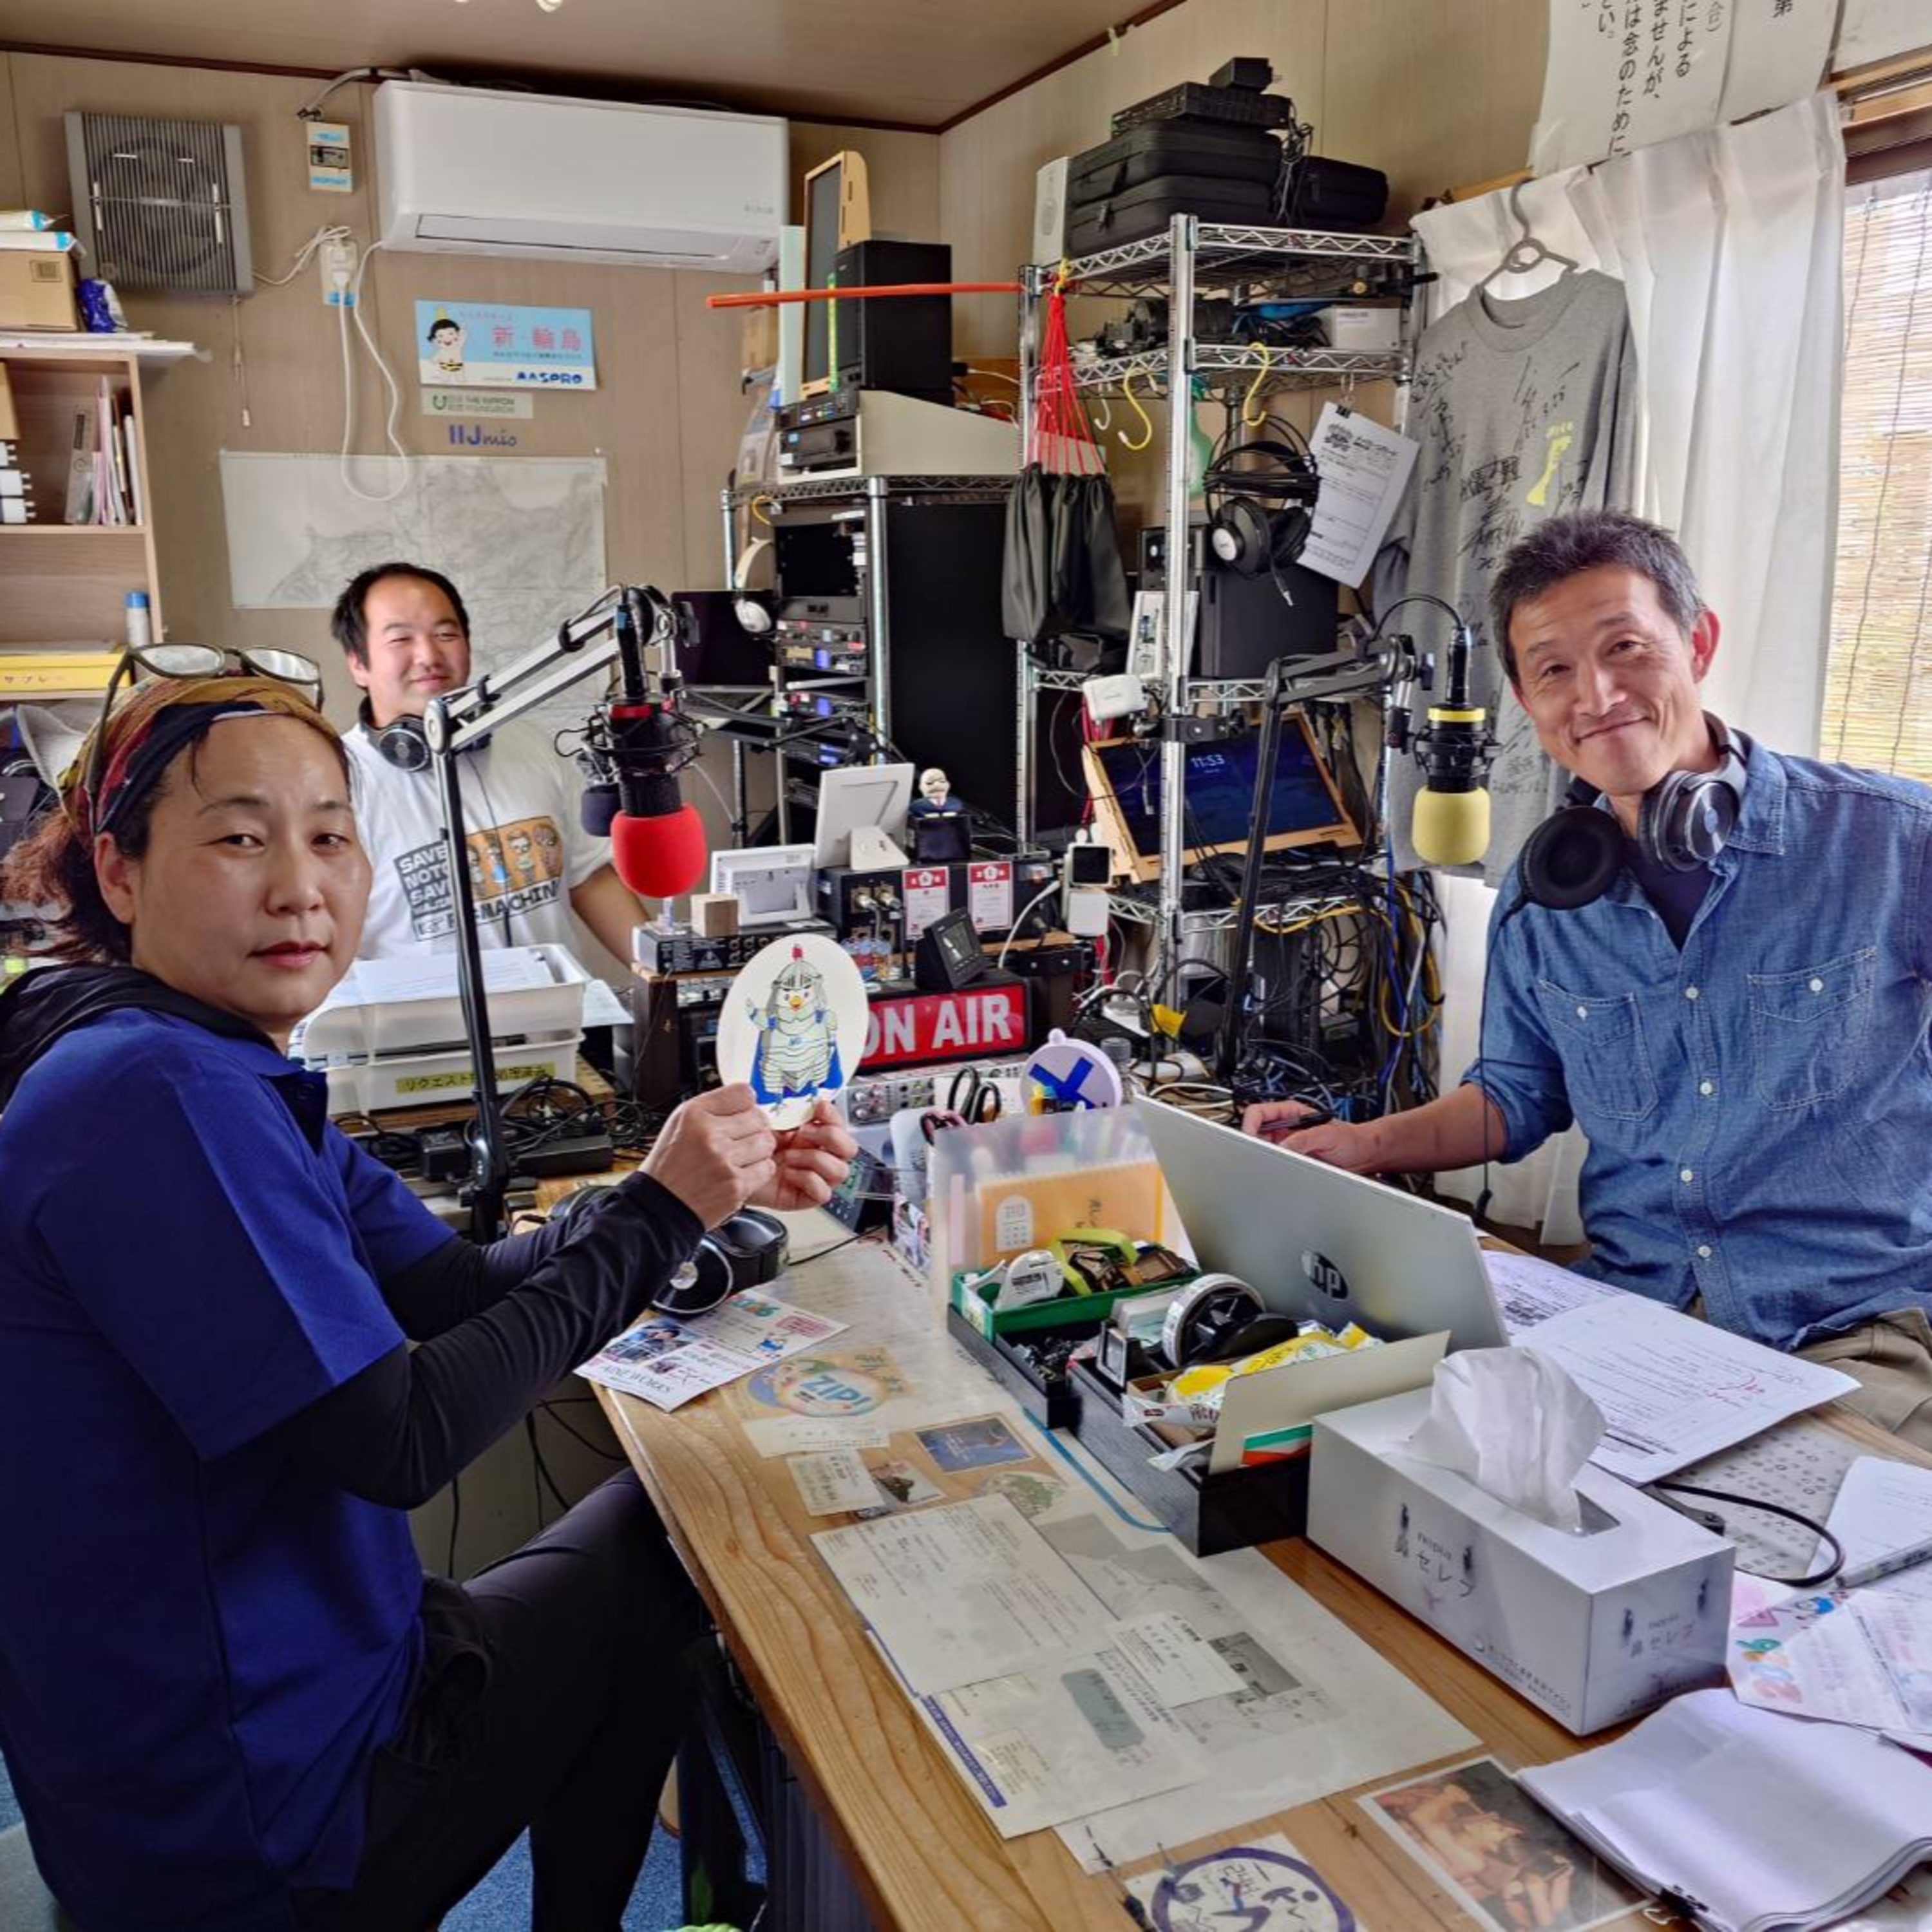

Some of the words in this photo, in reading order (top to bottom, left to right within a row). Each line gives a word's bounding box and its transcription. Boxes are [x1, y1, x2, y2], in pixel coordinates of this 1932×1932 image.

[1190, 753, 1225, 768] 11:53
[410, 880, 451, 905] SAV
[931, 994, 1013, 1049] AIR
[1308, 1254, 1341, 1300] hp
